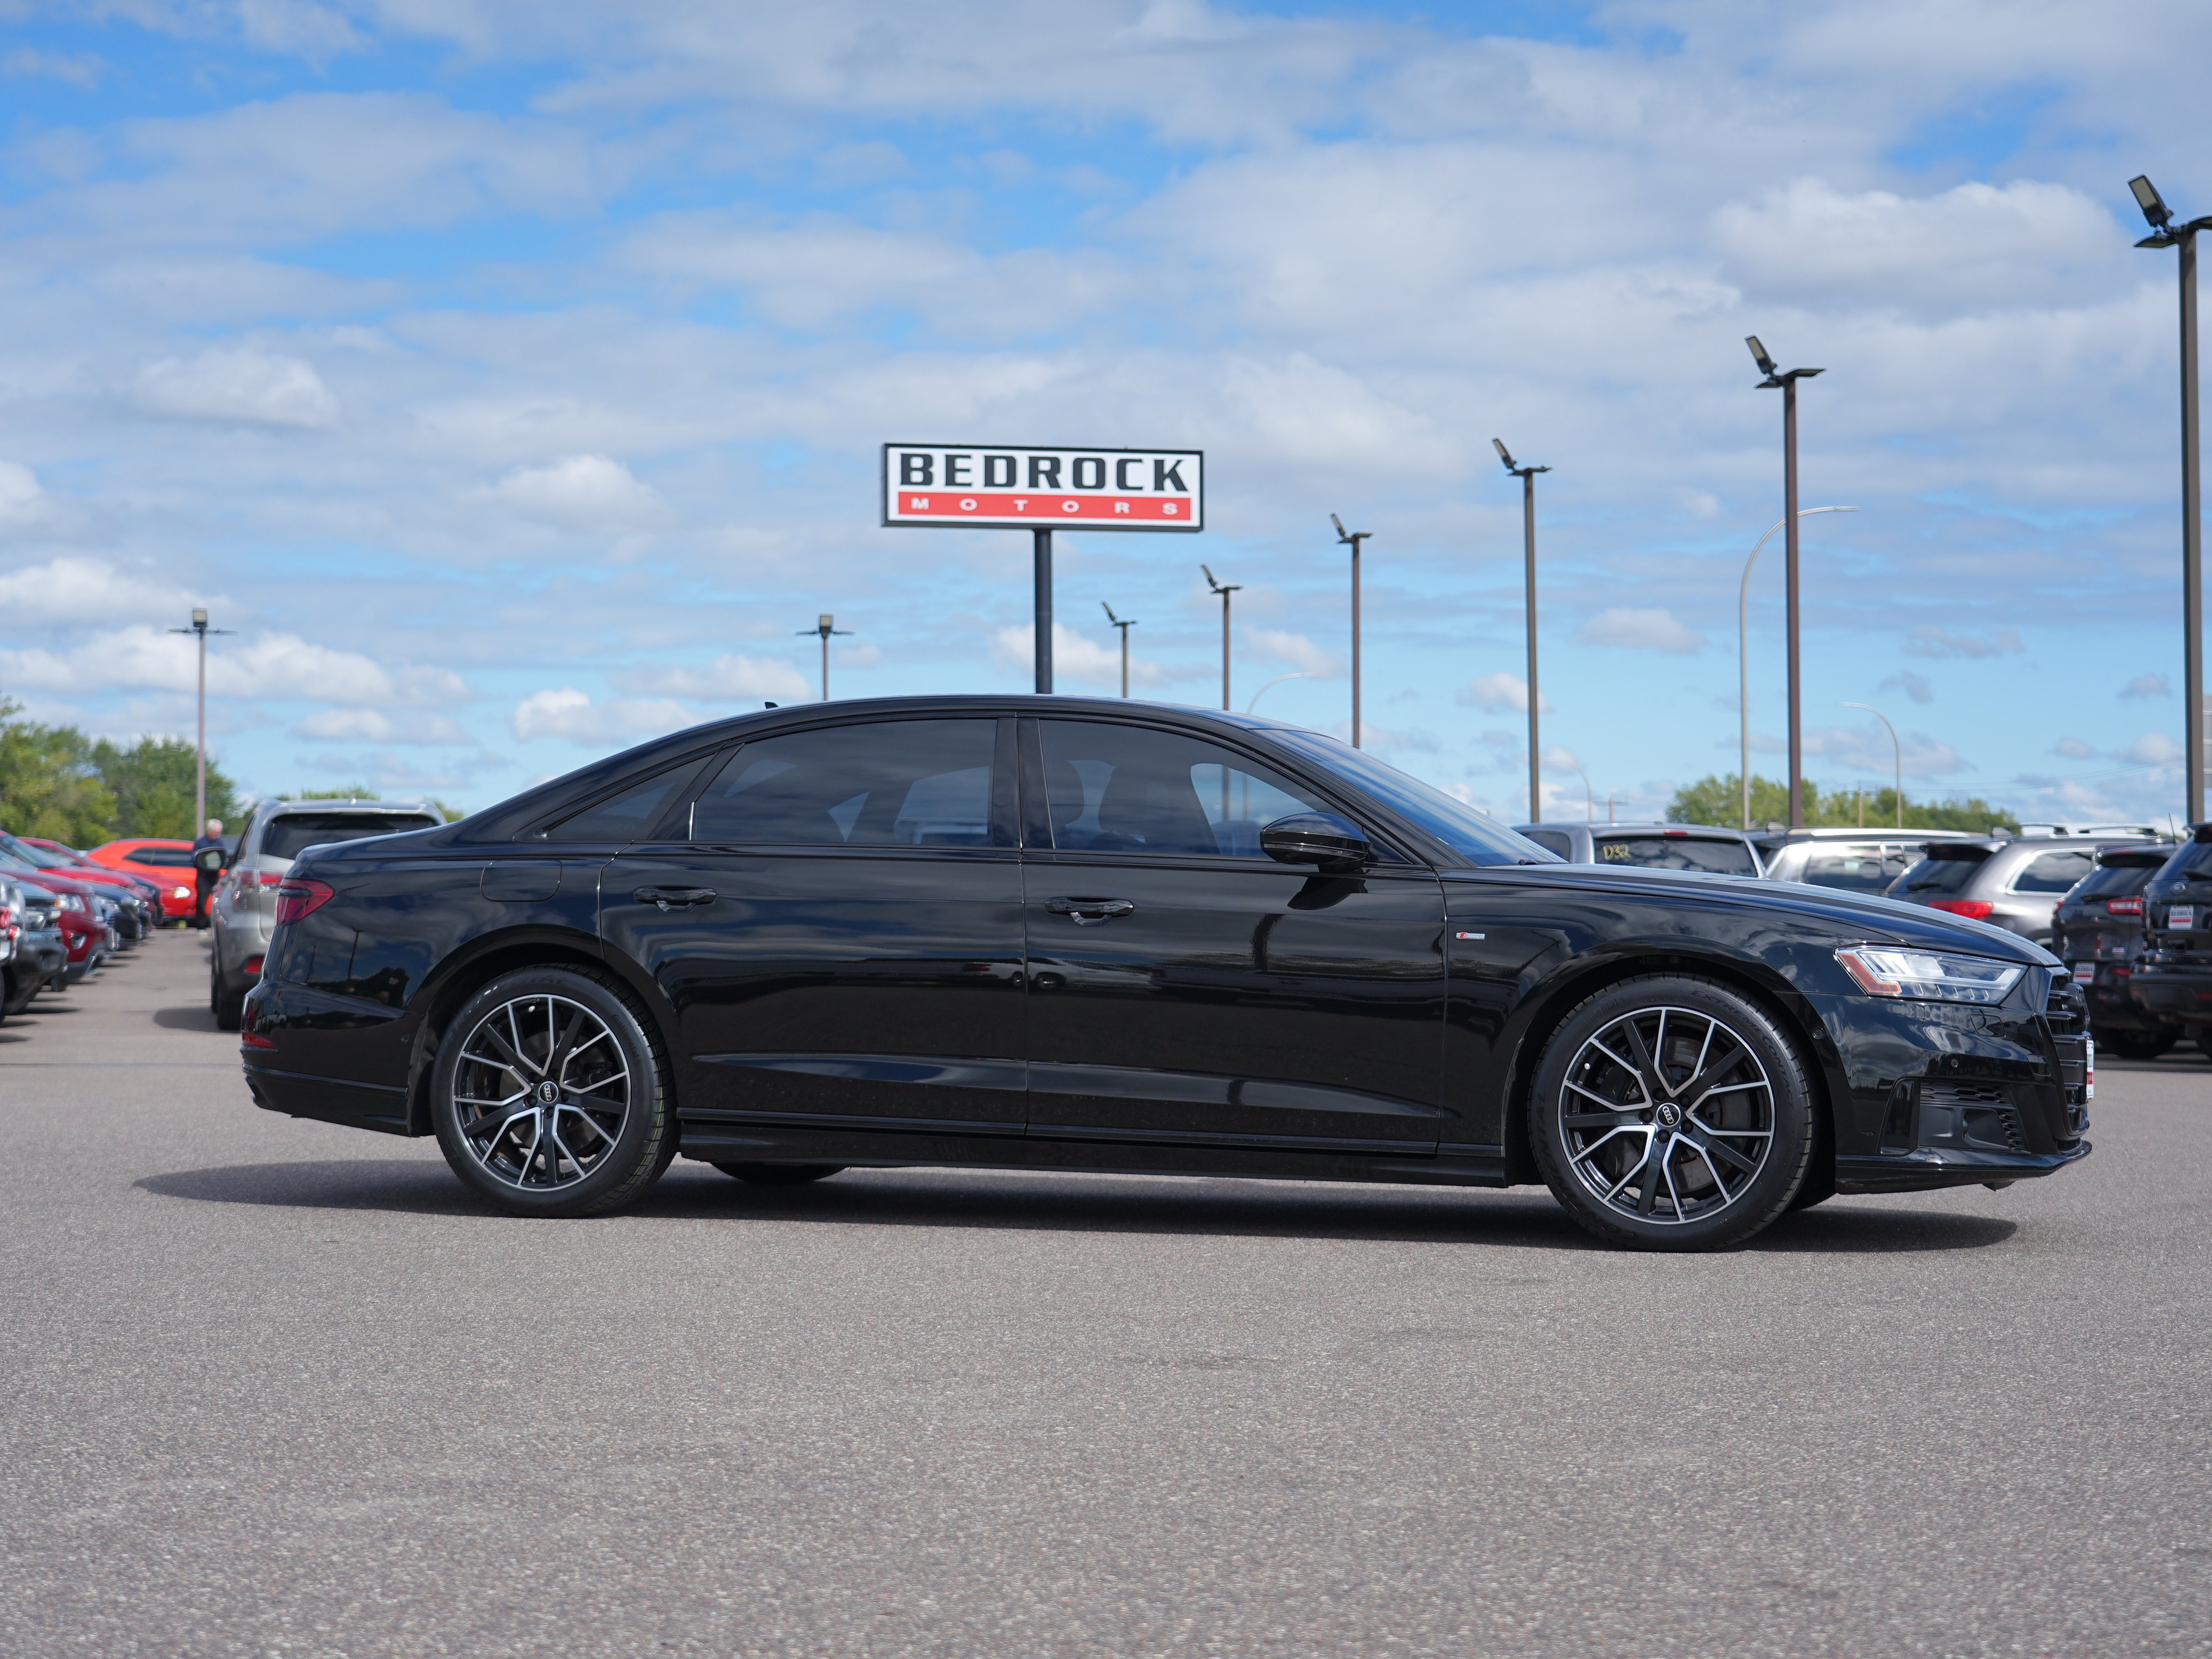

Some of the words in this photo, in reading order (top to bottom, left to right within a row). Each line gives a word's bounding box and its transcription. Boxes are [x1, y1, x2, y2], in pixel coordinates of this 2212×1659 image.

[900, 453, 1189, 492] BEDROCK
[911, 497, 1178, 515] MOTORS
[1603, 844, 1631, 860] D32
